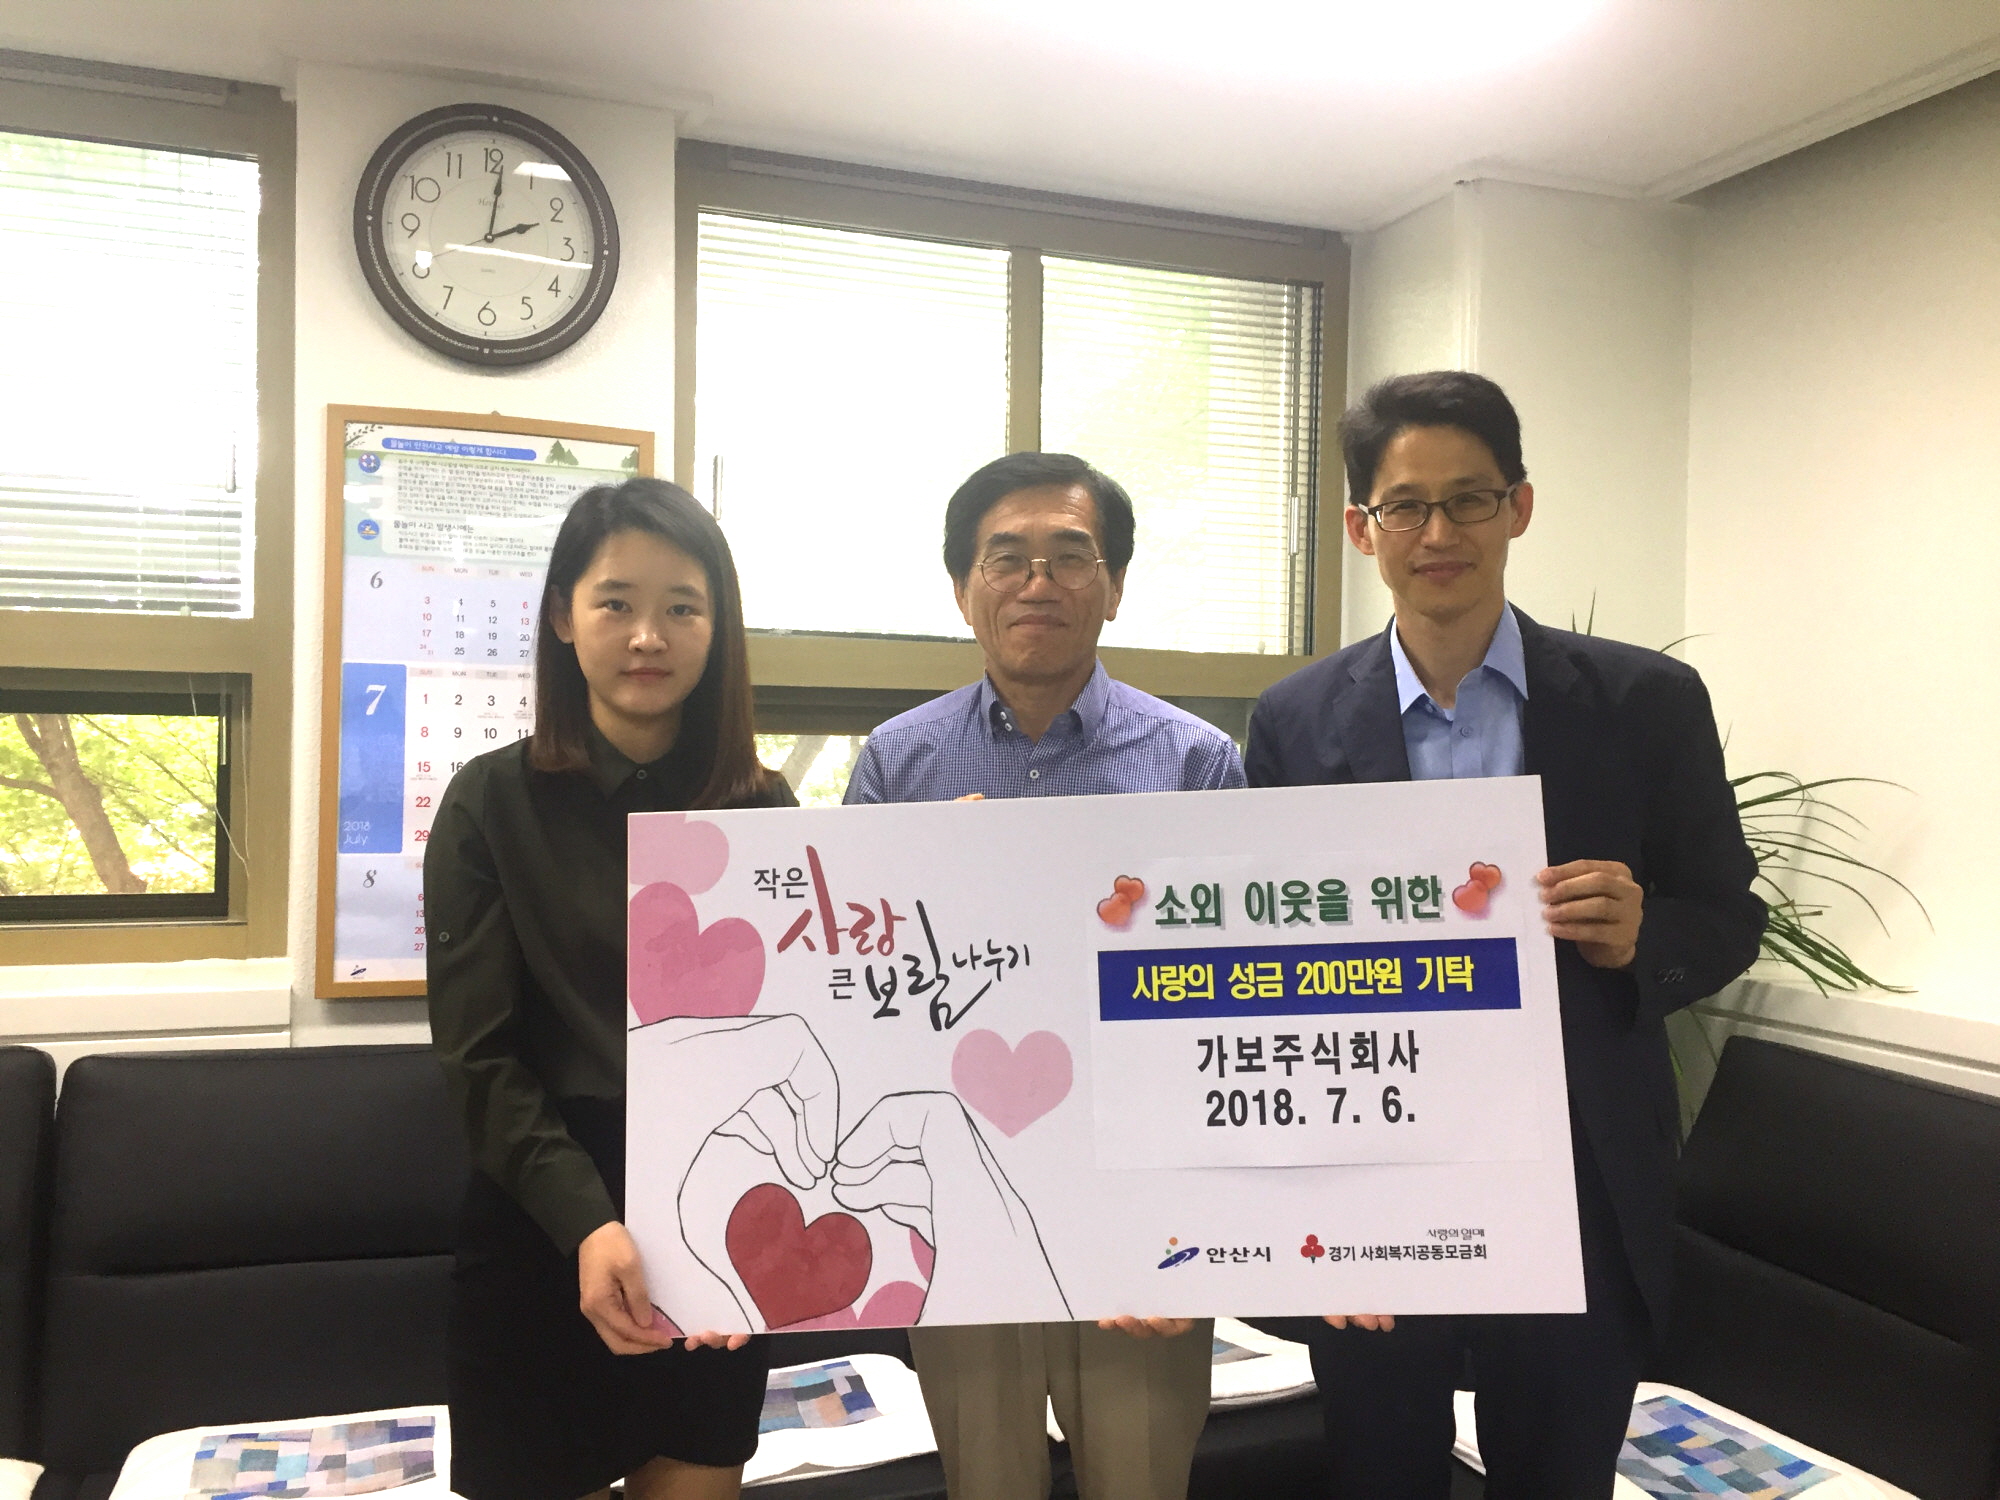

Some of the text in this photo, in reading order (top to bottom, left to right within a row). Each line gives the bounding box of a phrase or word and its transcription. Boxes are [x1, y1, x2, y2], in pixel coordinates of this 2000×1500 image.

[446, 152, 462, 179] 11
[484, 148, 503, 174] 12
[409, 175, 440, 203] 10
[550, 198, 563, 223] 2
[401, 213, 420, 238] 9
[560, 237, 575, 262] 3
[547, 275, 561, 298] 4
[443, 285, 453, 310] 7
[477, 301, 496, 326] 6
[520, 296, 534, 320] 5
[370, 571, 384, 589] 6
[424, 596, 431, 605] 3
[490, 600, 496, 608] 5
[522, 601, 528, 609] 6
[422, 613, 530, 625] 10 11 12 13
[422, 629, 530, 641] 17 18 19 20
[454, 647, 465, 656] 25
[487, 648, 498, 656] 26
[519, 650, 529, 658] 27
[365, 684, 387, 716] 7
[423, 694, 527, 707] 1 2 3 4
[420, 726, 529, 739] 8 9 10 11
[417, 761, 463, 773] 15 16
[415, 796, 431, 808] 22
[343, 821, 370, 831] 2018
[414, 830, 430, 841] 29
[343, 834, 368, 846] July
[363, 869, 377, 888] 8
[753, 845, 907, 956] 작은 사랑
[1154, 873, 1445, 927] 소외 이웃을 위한
[415, 926, 425, 934] 20
[414, 942, 424, 951] 27
[828, 968, 856, 1000] 큰
[952, 938, 1030, 982] 나누기
[1132, 954, 1475, 1002] 사랑의 성금 200만원 기탁
[1197, 1029, 1420, 1079] 가보주식회사
[1206, 1084, 1416, 1128] 2018. 7. 6.
[1426, 1228, 1459, 1241] 사랑의
[1206, 1245, 1272, 1264] 안산시
[1328, 1243, 1487, 1262] 경기 사회복지공동모금회
